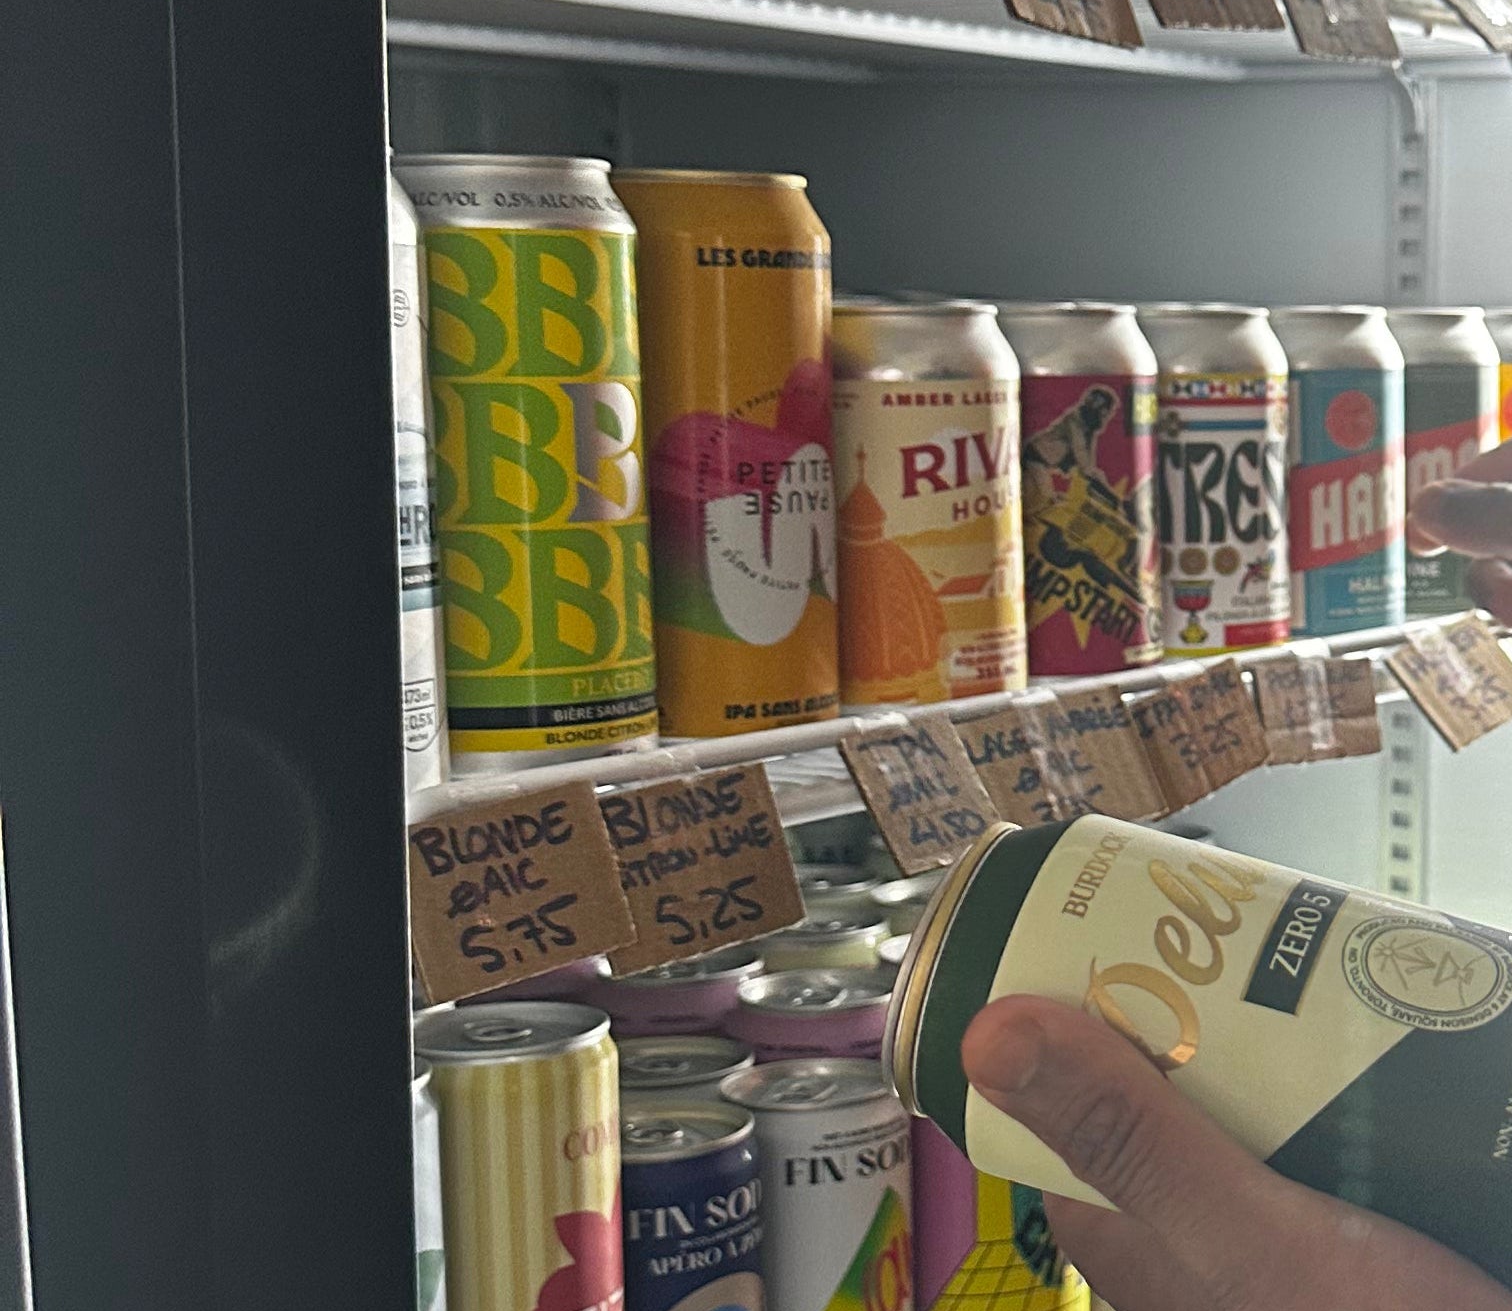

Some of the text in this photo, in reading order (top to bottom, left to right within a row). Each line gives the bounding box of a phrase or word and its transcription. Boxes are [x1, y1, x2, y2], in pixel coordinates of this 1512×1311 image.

[697, 247, 736, 268] LES
[881, 392, 955, 408] AMBER
[735, 458, 832, 485] PETITE
[725, 703, 758, 720] IPA
[545, 726, 604, 745] BLONDE
[599, 772, 746, 850] BLONDE
[410, 800, 574, 878] BLONDE
[1061, 830, 1130, 920] BURDOCK
[785, 1156, 845, 1187] FIN
[628, 1202, 697, 1241] FIN
